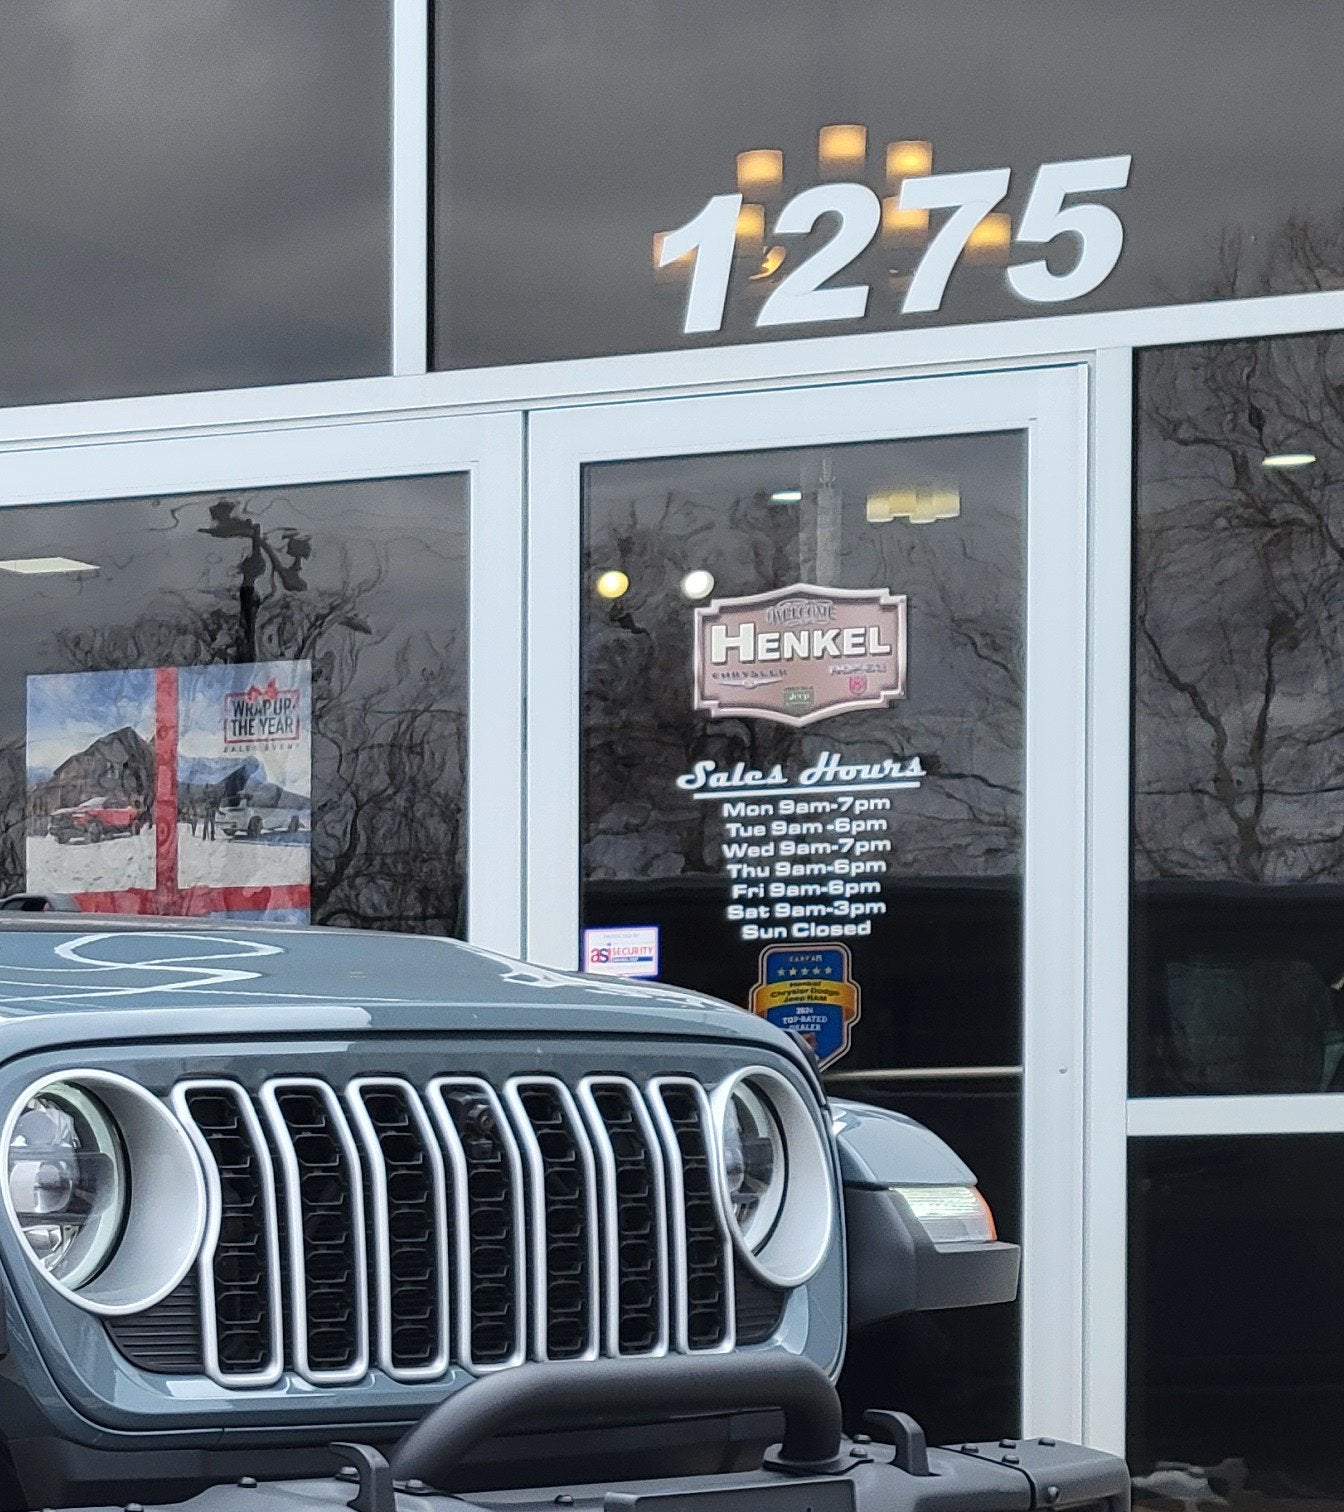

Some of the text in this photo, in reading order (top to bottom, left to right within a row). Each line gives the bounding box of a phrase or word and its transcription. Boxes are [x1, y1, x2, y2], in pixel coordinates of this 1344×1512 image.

[657, 154, 1132, 334] 1275
[711, 622, 892, 665] HENKEL
[232, 697, 292, 717] WRAP UP
[231, 716, 293, 736] THE YEAR
[676, 751, 927, 789] Sales Hours
[723, 796, 891, 817] Mon 9am-7pm
[726, 817, 888, 837] Tue 9am -6pm
[722, 837, 892, 858] Wed 9am-7pm
[726, 858, 887, 881] Thu 9am-6pm
[732, 879, 882, 899] Fri 9am-6pm
[727, 900, 887, 920] Sat 9am-3pm
[741, 920, 872, 940] Sun Closed
[612, 946, 653, 956] SECURITY
[782, 1015, 828, 1025] TOP-RATED
